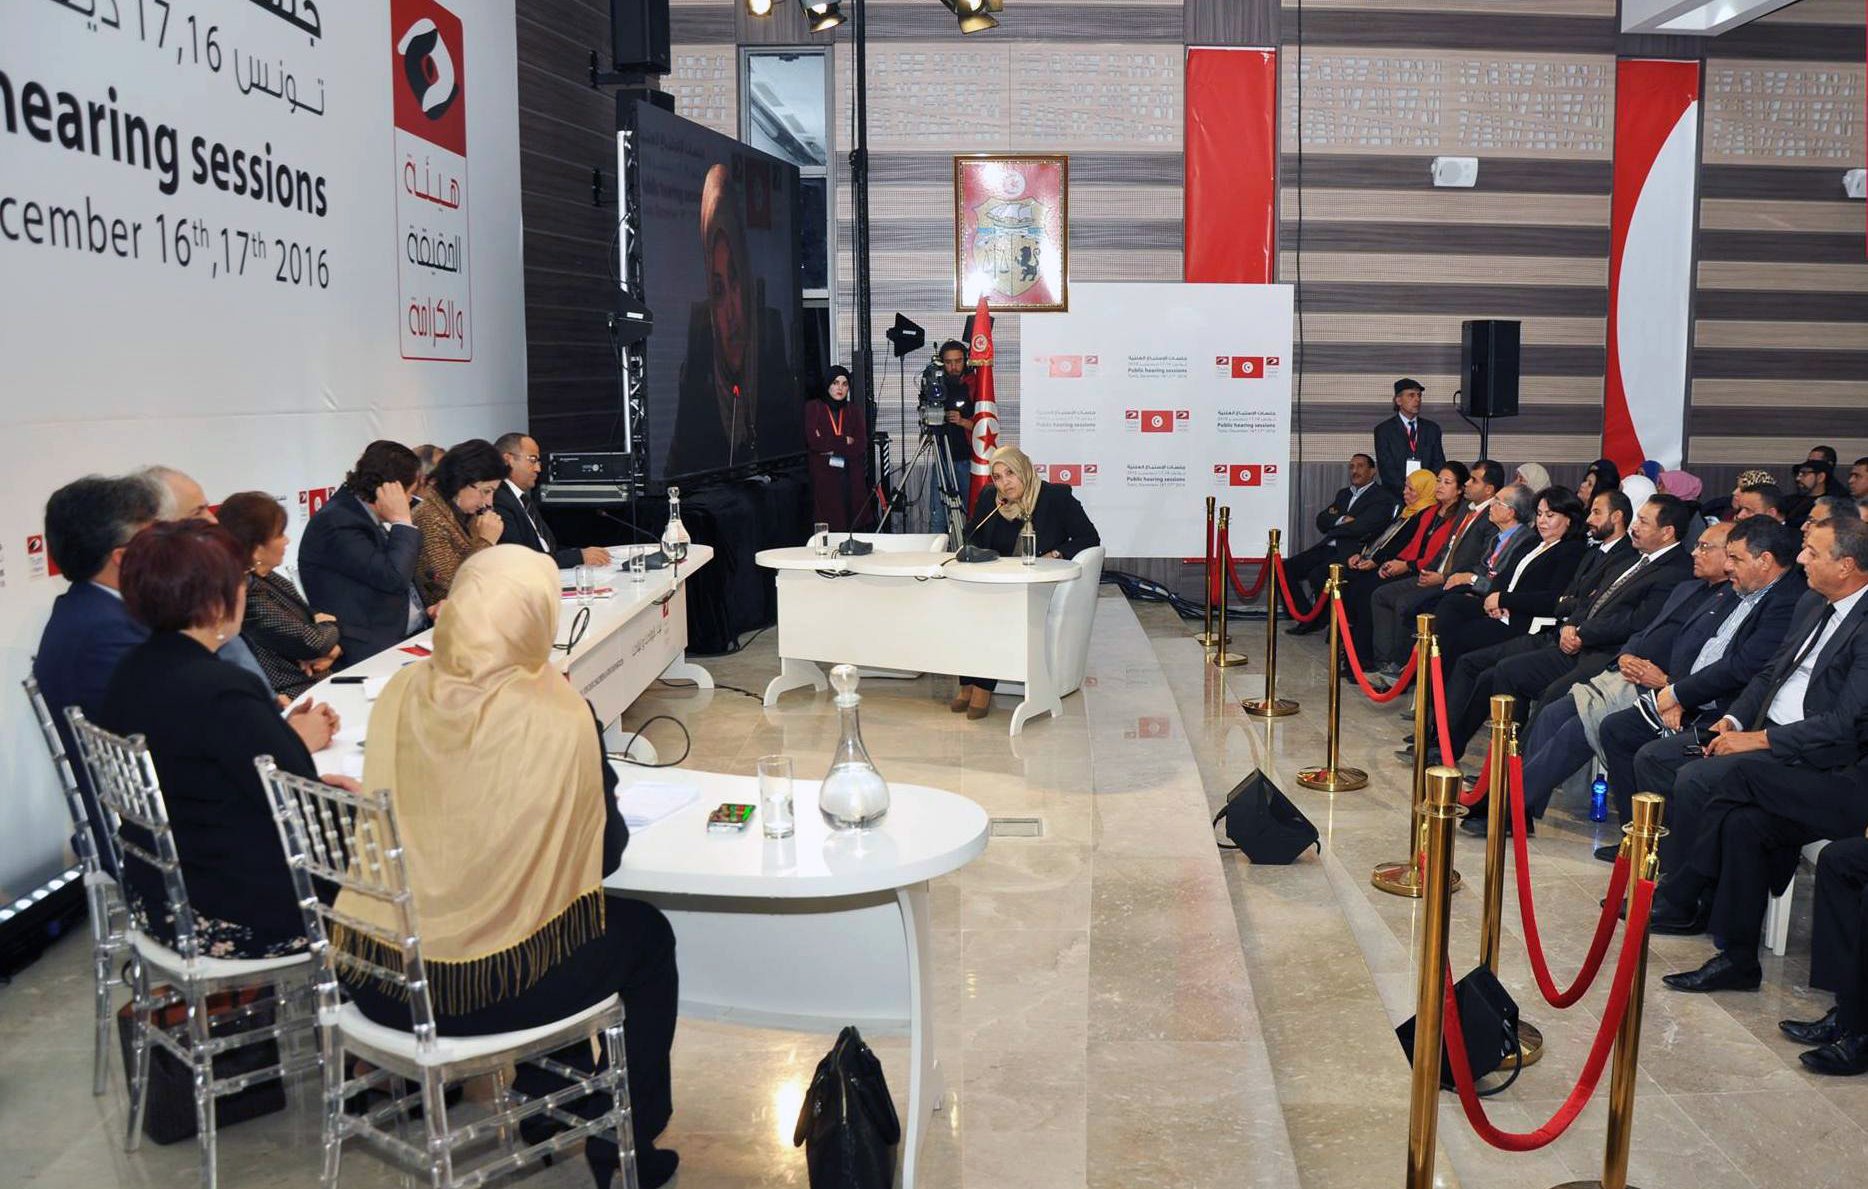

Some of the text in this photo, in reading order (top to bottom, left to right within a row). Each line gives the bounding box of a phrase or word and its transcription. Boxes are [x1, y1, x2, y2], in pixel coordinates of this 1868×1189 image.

[234, 48, 324, 116] تونس
[191, 135, 327, 217] sessions
[275, 239, 329, 289] 2016
